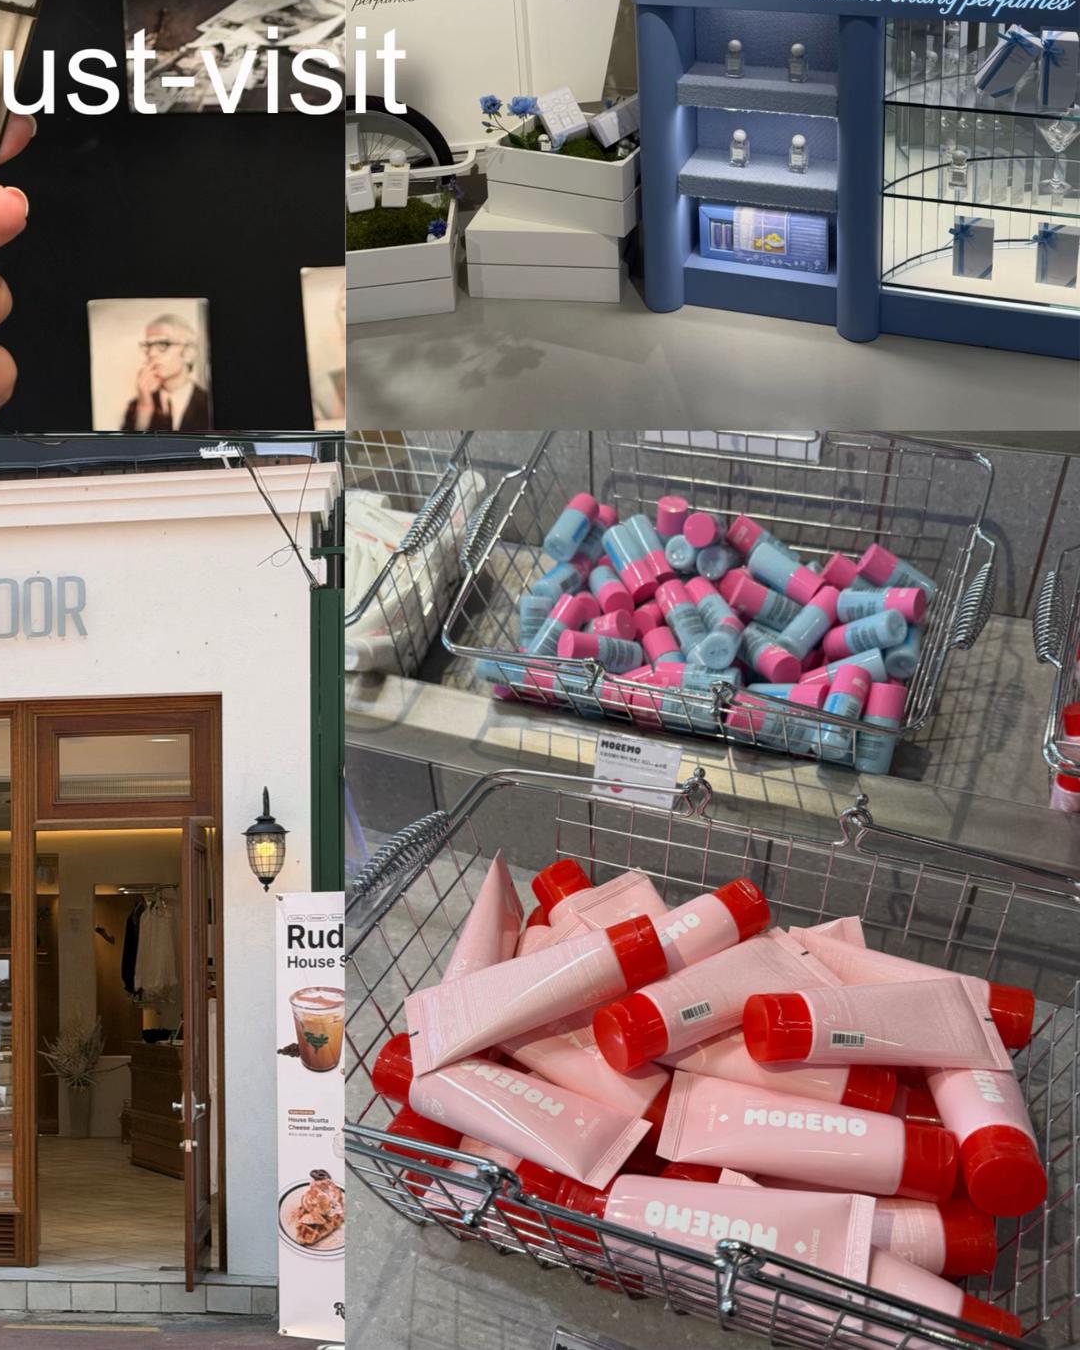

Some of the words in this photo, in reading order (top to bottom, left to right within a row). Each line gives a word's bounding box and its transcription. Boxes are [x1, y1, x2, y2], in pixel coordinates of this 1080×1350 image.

[601, 740, 641, 755] MOREMO
[287, 924, 344, 949] Rud
[287, 955, 335, 969] House
[744, 1108, 867, 1137] MOREMO
[645, 1201, 778, 1252] MOREMO
